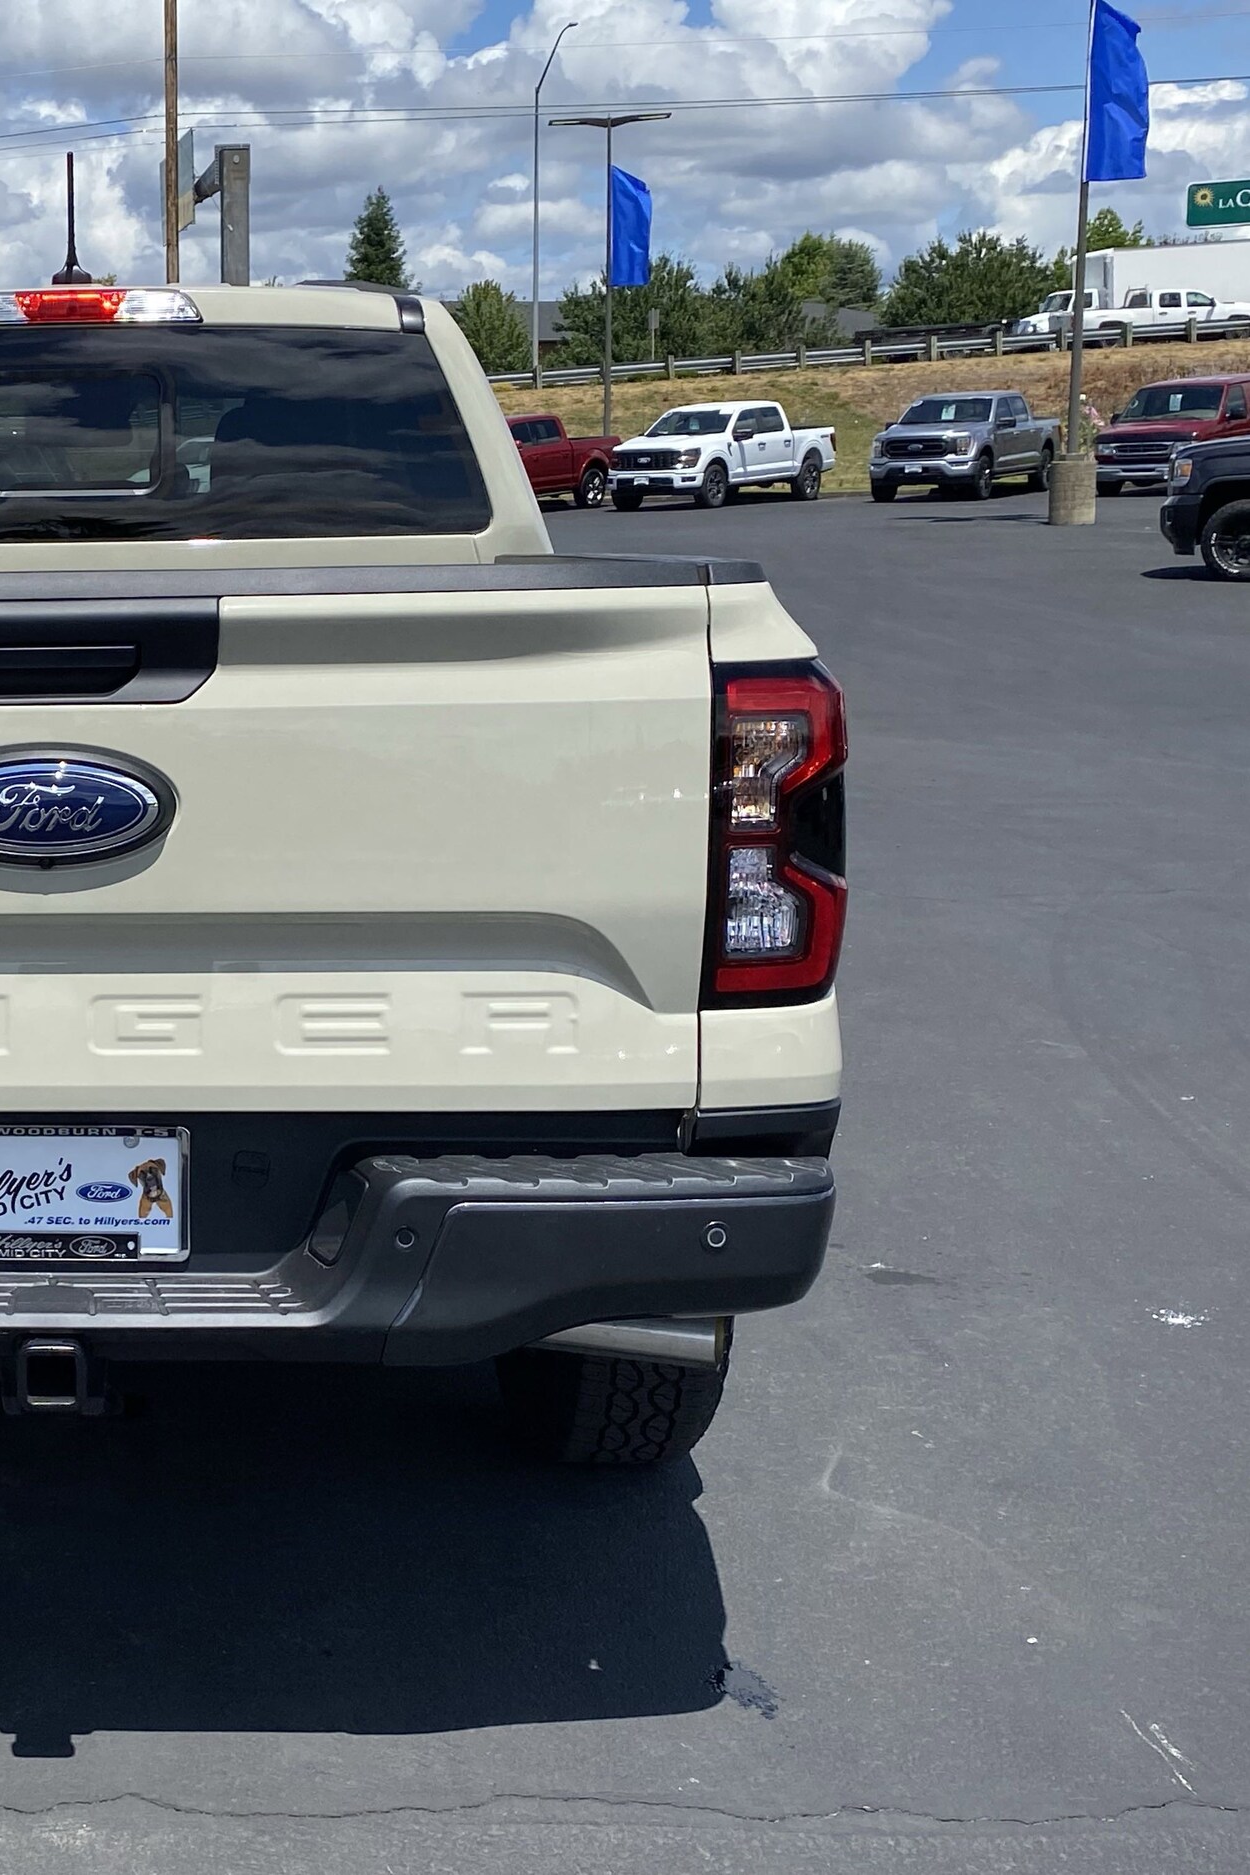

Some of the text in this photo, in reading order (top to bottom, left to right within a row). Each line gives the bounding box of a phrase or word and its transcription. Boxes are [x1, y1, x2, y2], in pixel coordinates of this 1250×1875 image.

[1218, 198, 1235, 209] LA
[19, 1185, 67, 1211] CITY
[86, 1184, 122, 1200] Ford
[24, 1216, 171, 1227] .47 SEC. to Hillyers.com
[78, 1238, 107, 1254] Ford
[29, 1249, 67, 1258] CITY
